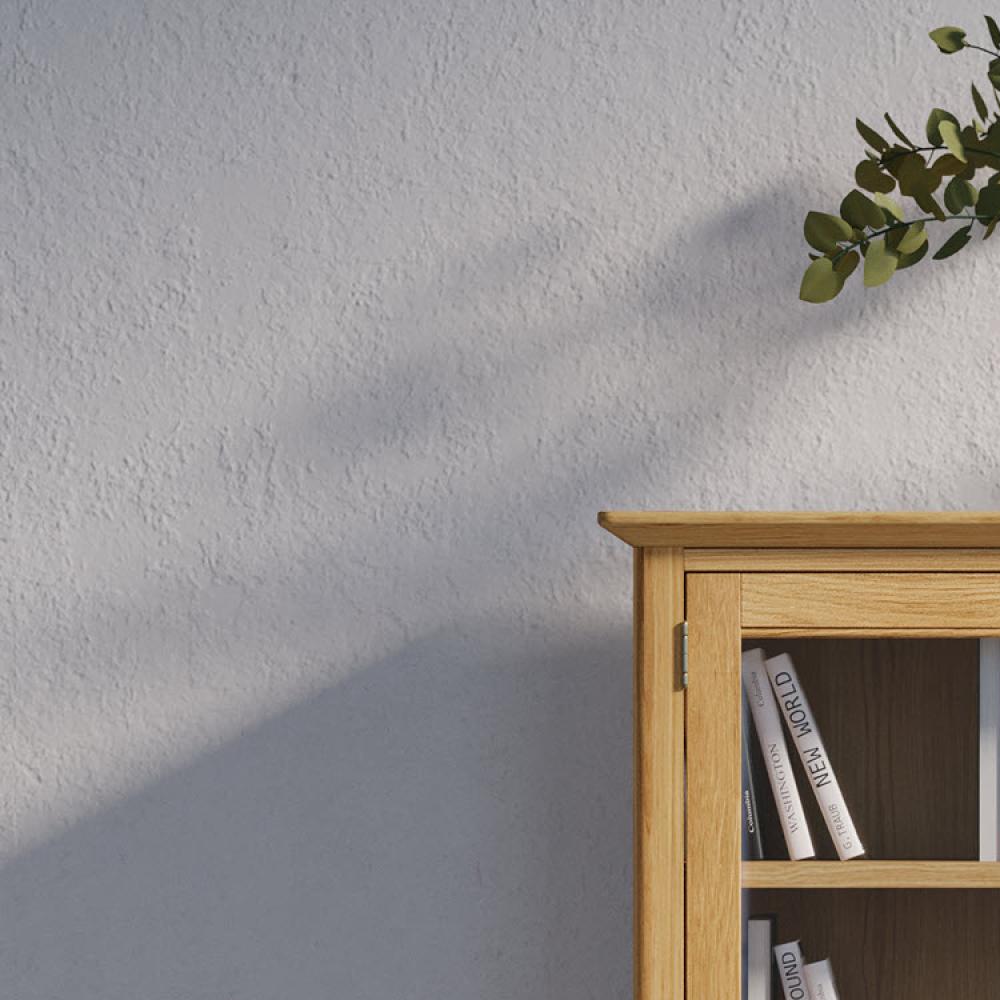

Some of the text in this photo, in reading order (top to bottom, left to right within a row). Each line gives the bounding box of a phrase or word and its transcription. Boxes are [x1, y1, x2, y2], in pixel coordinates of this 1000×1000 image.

[775, 671, 812, 738] WORLD
[768, 743, 799, 834] WASHINGTON
[804, 747, 831, 788] NEW
[828, 803, 849, 837] TRAUB
